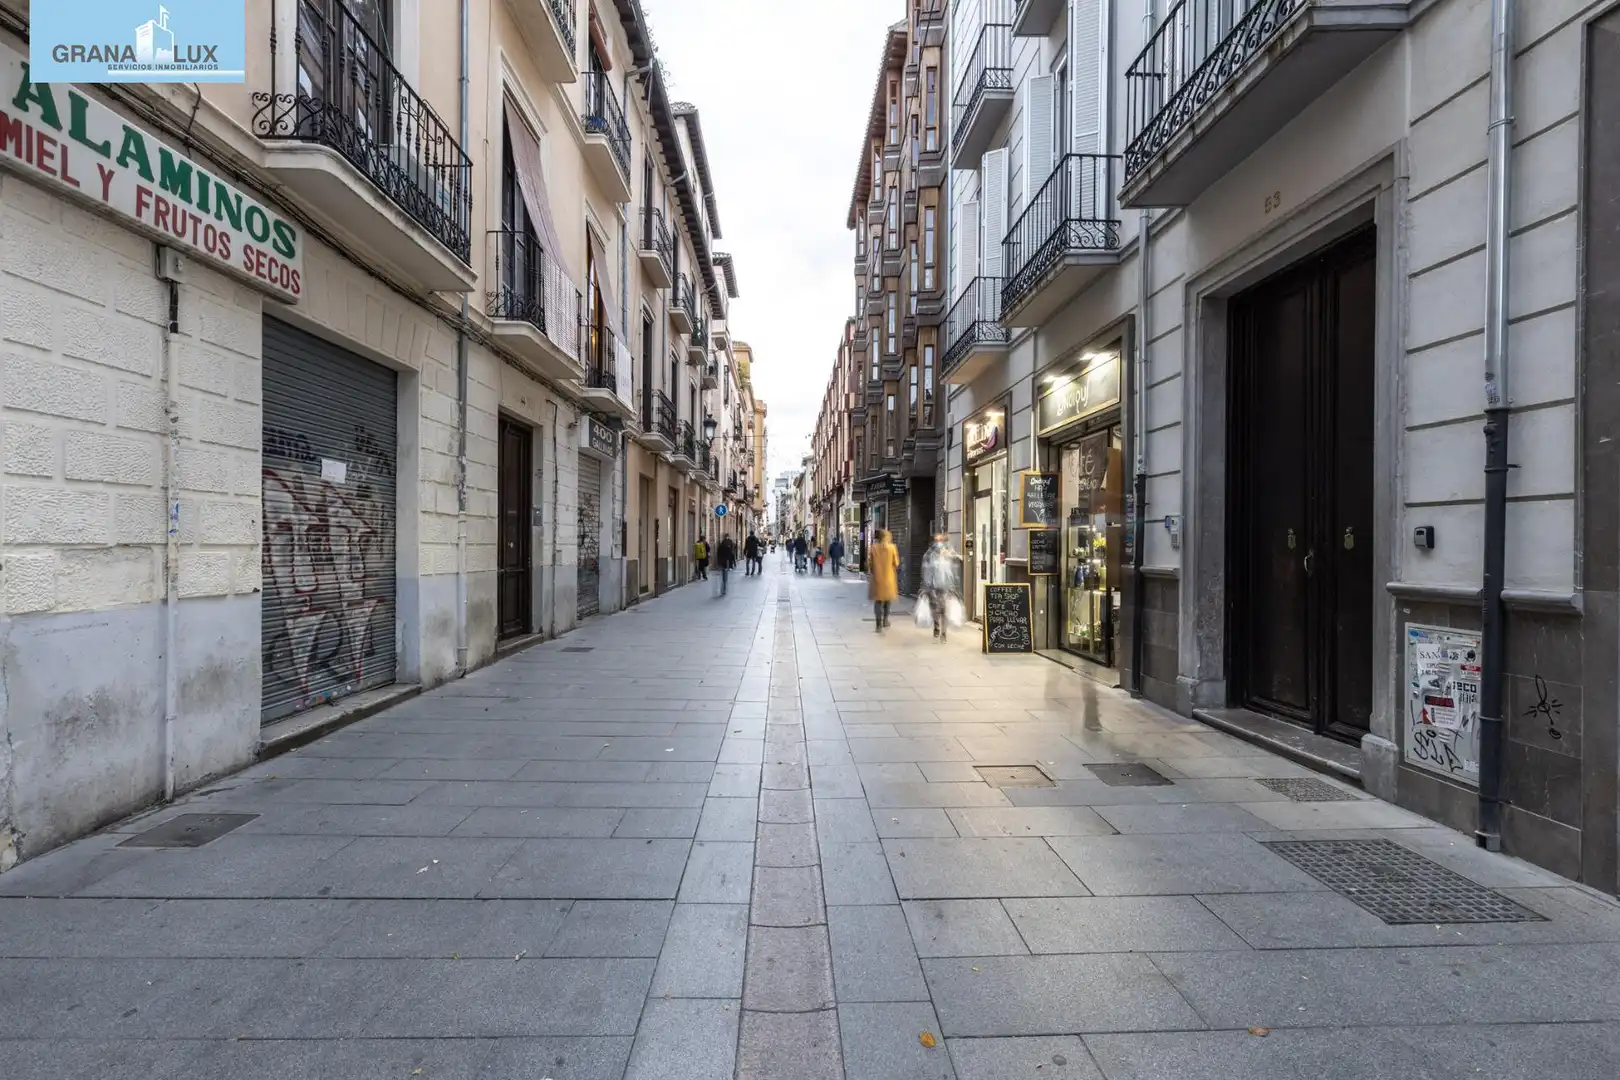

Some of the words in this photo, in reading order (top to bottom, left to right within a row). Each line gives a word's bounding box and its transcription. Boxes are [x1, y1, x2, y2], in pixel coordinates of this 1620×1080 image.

[0, 110, 81, 188] MIEL
[96, 162, 115, 203] Y
[135, 184, 231, 261] FRUTOS
[243, 243, 301, 295] SECOS
[12, 60, 297, 260] ALAMINOS
[1264, 190, 1281, 214] 63
[593, 424, 612, 443] 400
